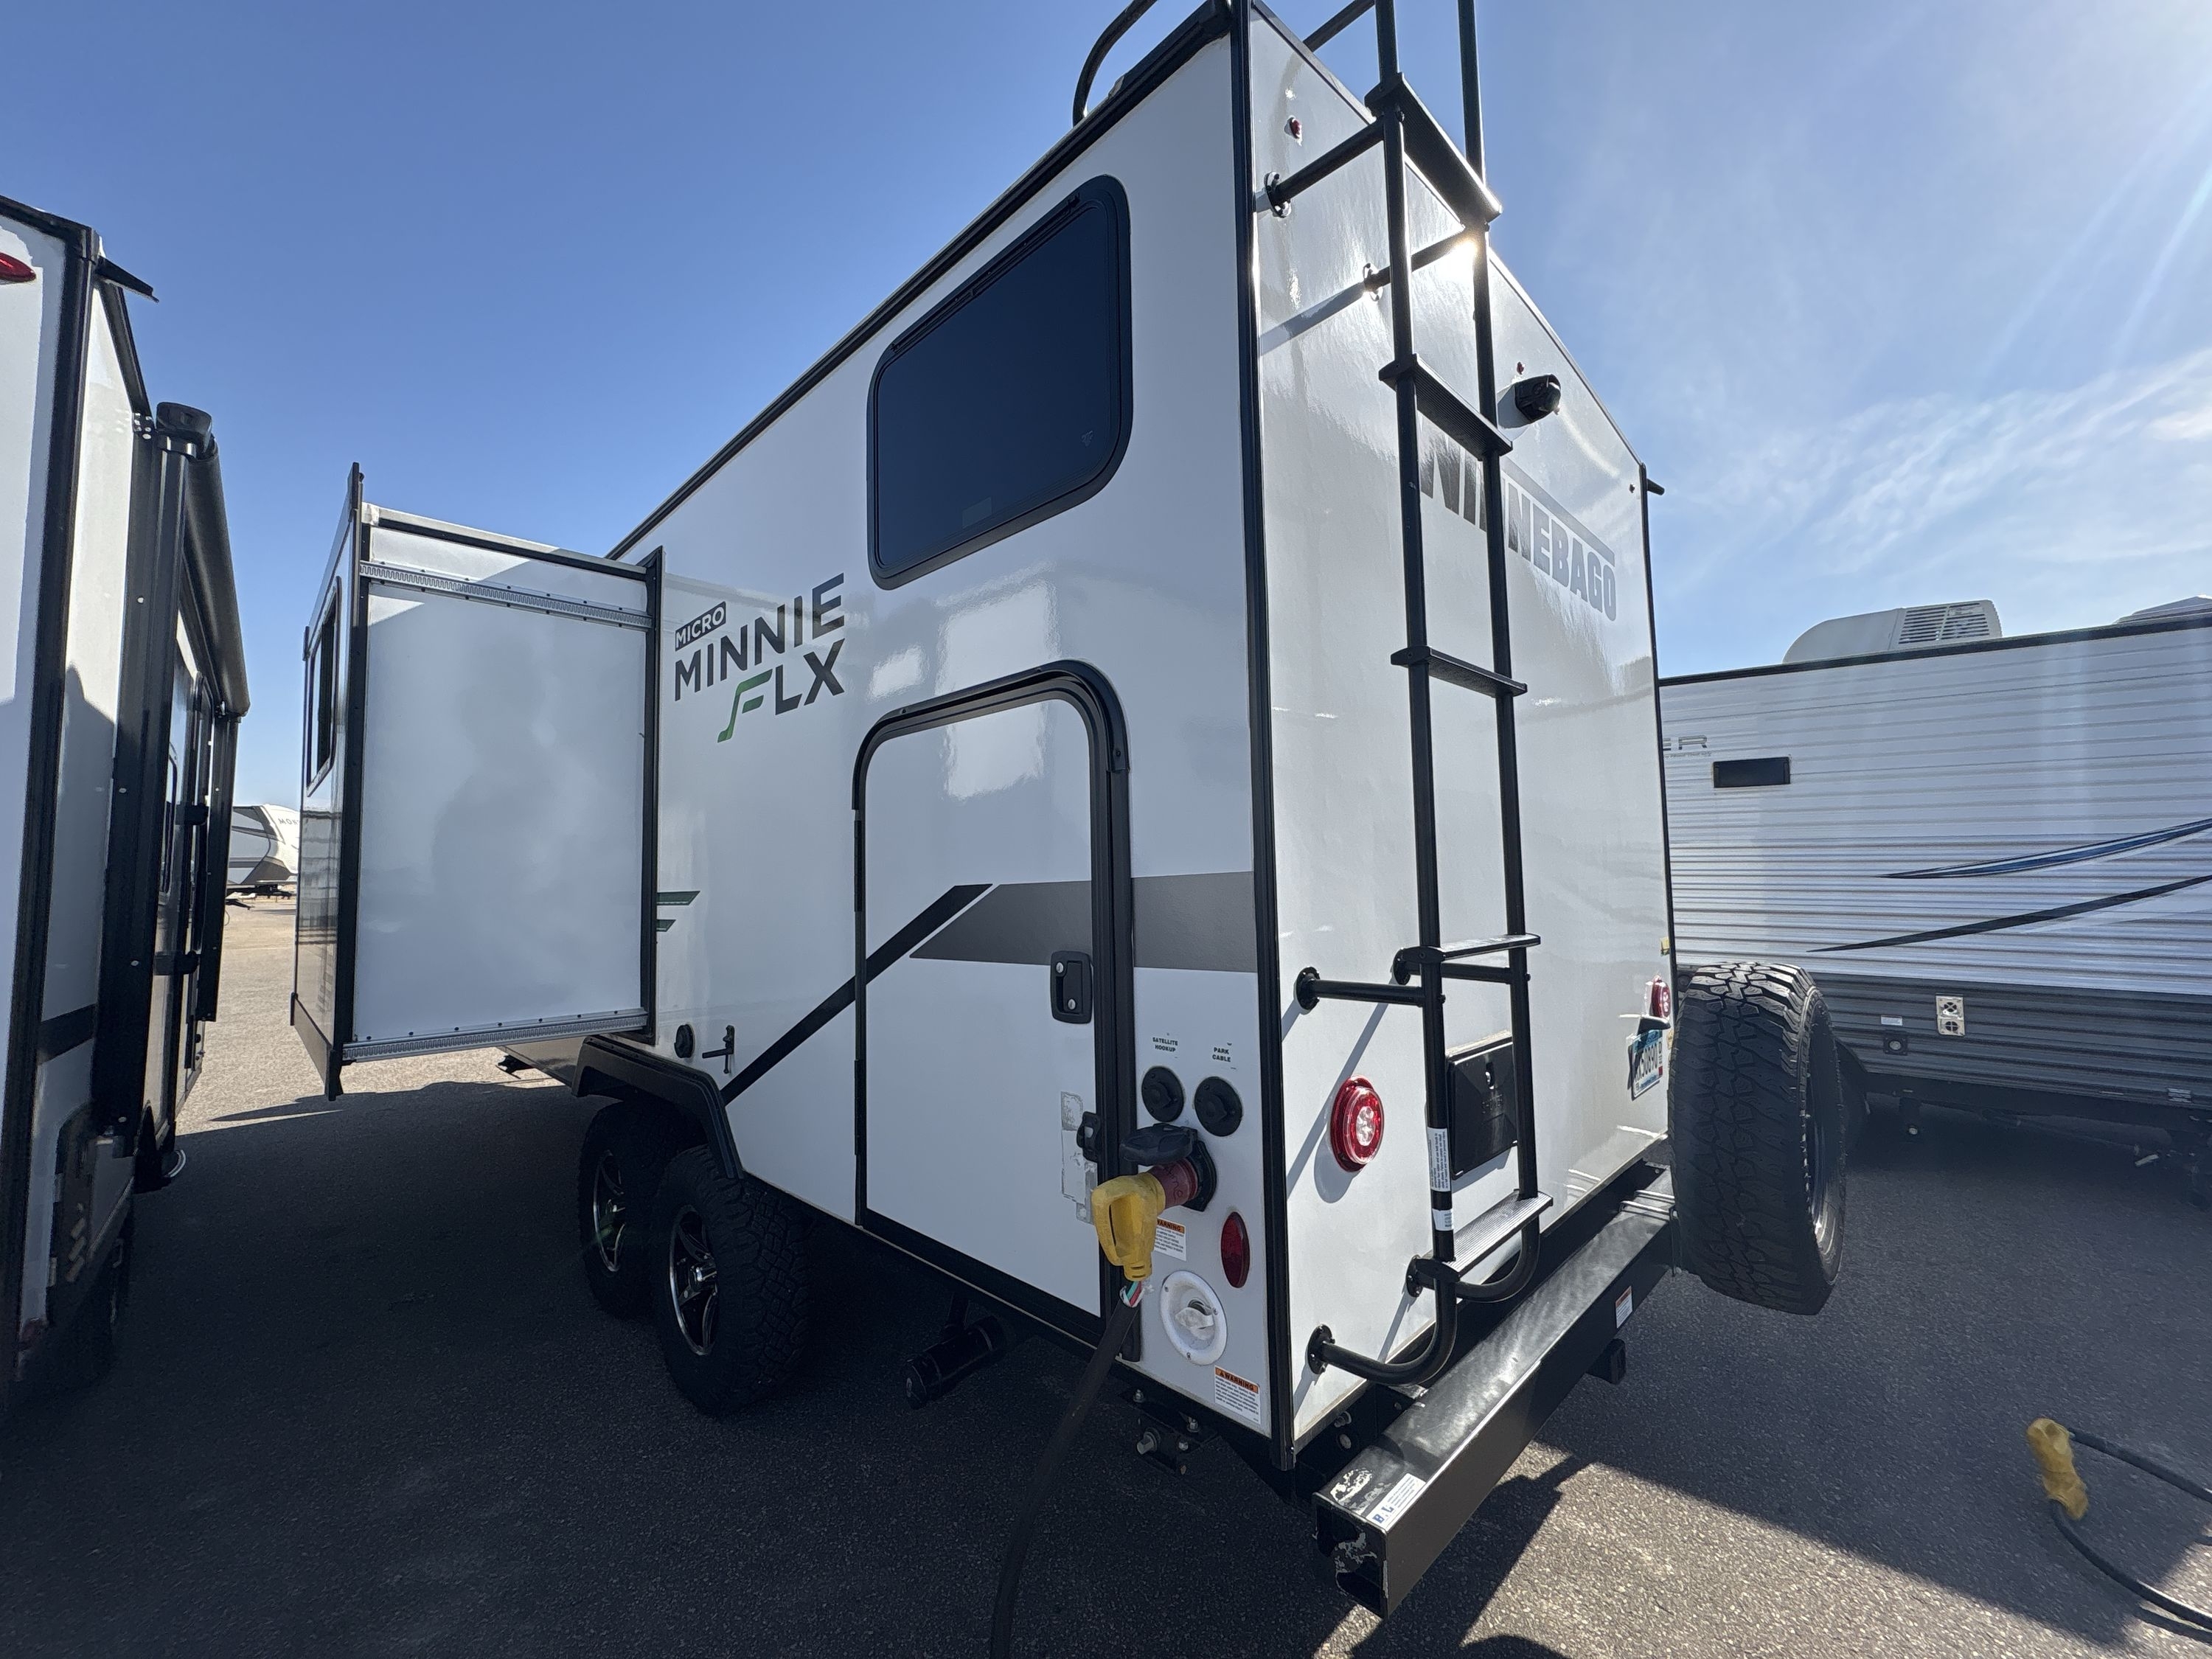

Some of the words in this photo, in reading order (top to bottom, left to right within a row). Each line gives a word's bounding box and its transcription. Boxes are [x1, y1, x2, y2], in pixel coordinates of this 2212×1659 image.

[675, 605, 725, 649] MICRO
[675, 572, 844, 702] MINNIE
[717, 638, 846, 743] FLX
[1152, 1037, 1178, 1046] SATELLITE
[1155, 1044, 1176, 1052] HOOKUP
[1214, 1047, 1229, 1055] PARK
[1212, 1054, 1231, 1062] CABLE
[1225, 1373, 1254, 1391] WARNING
